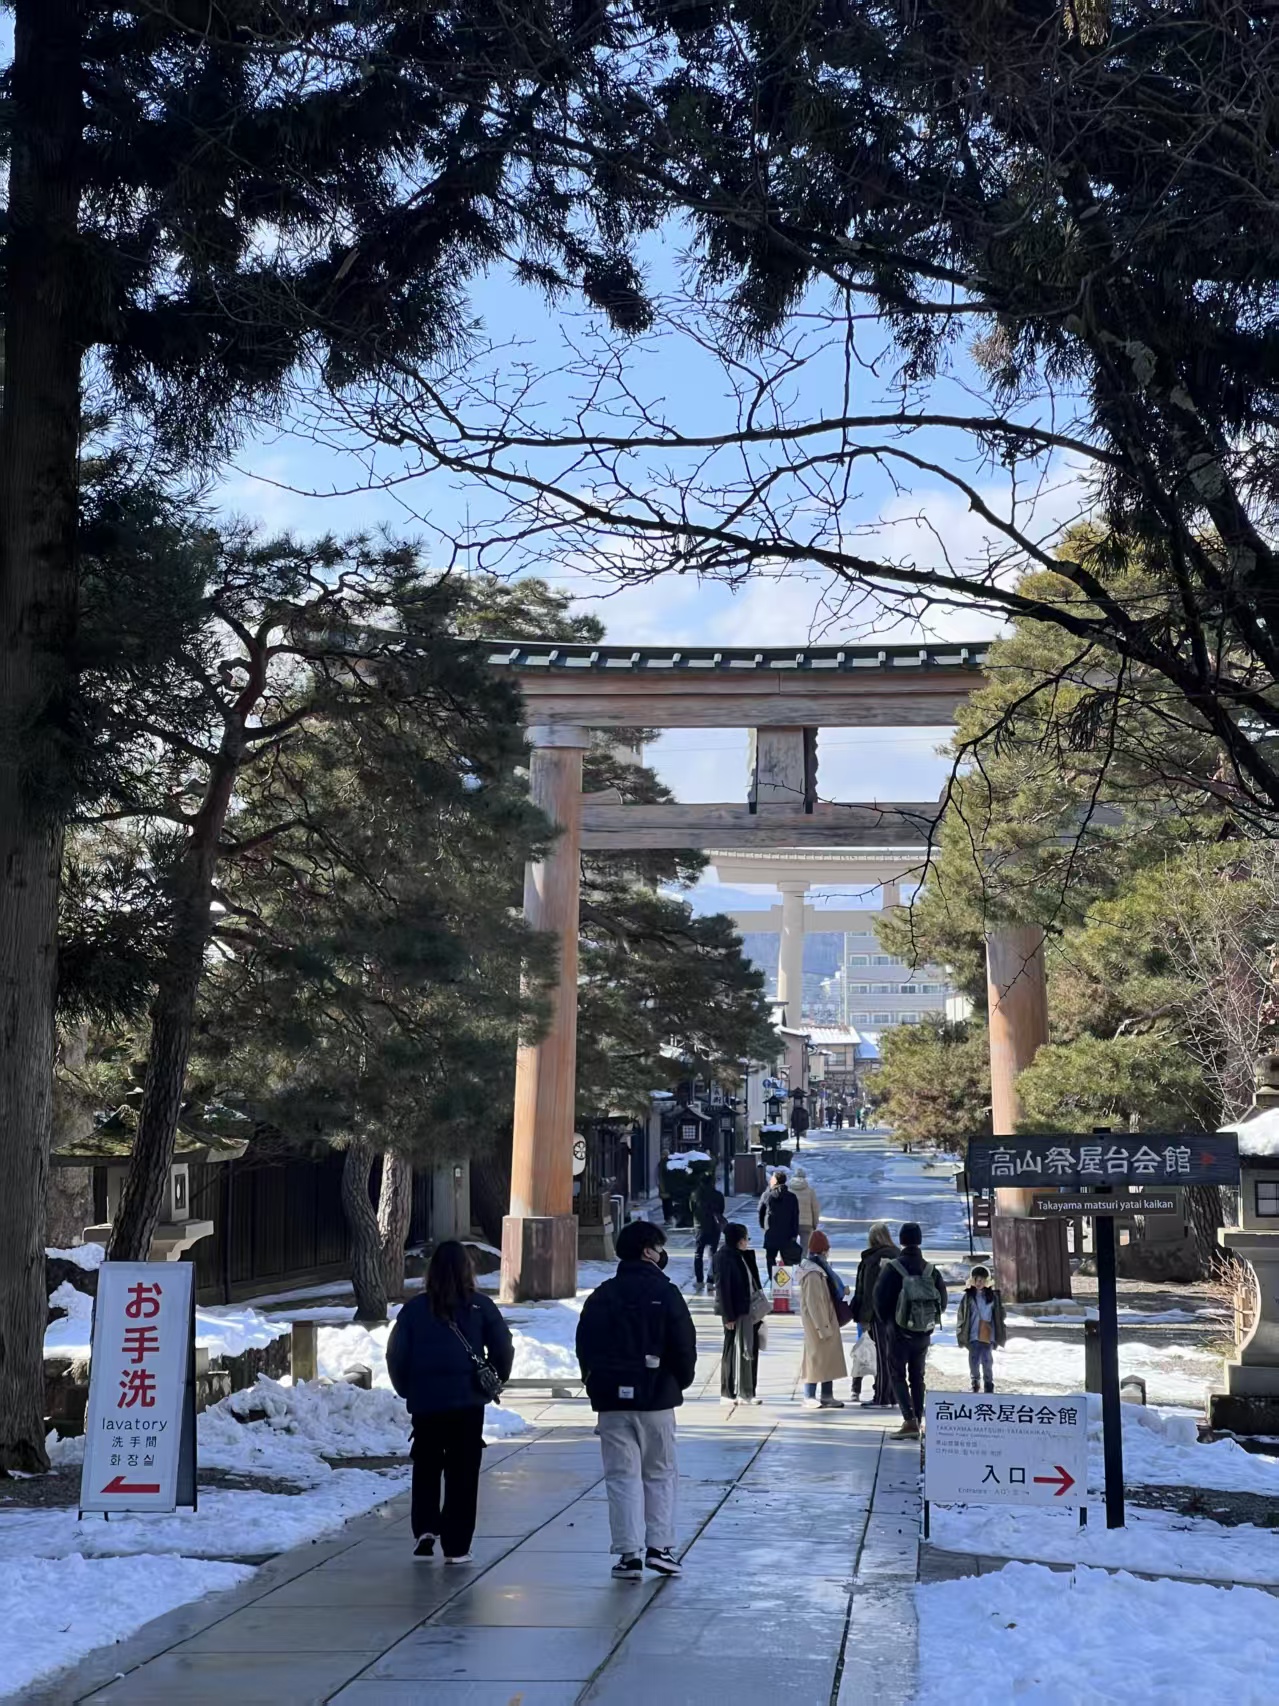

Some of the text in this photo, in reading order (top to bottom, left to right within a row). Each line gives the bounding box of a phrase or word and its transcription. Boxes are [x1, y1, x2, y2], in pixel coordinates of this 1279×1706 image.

[988, 1145, 1191, 1176] 高山祭屋台会館
[1037, 1200, 1174, 1211] Takayama matsuri yatai kaikan
[117, 1282, 162, 1408] お手洗
[935, 1400, 1078, 1425] 高山祭屋台会館
[102, 1417, 167, 1431] lavatory
[112, 1436, 157, 1448] 洗手間
[110, 1454, 155, 1467] 화장실
[982, 1465, 1026, 1484] 入口
